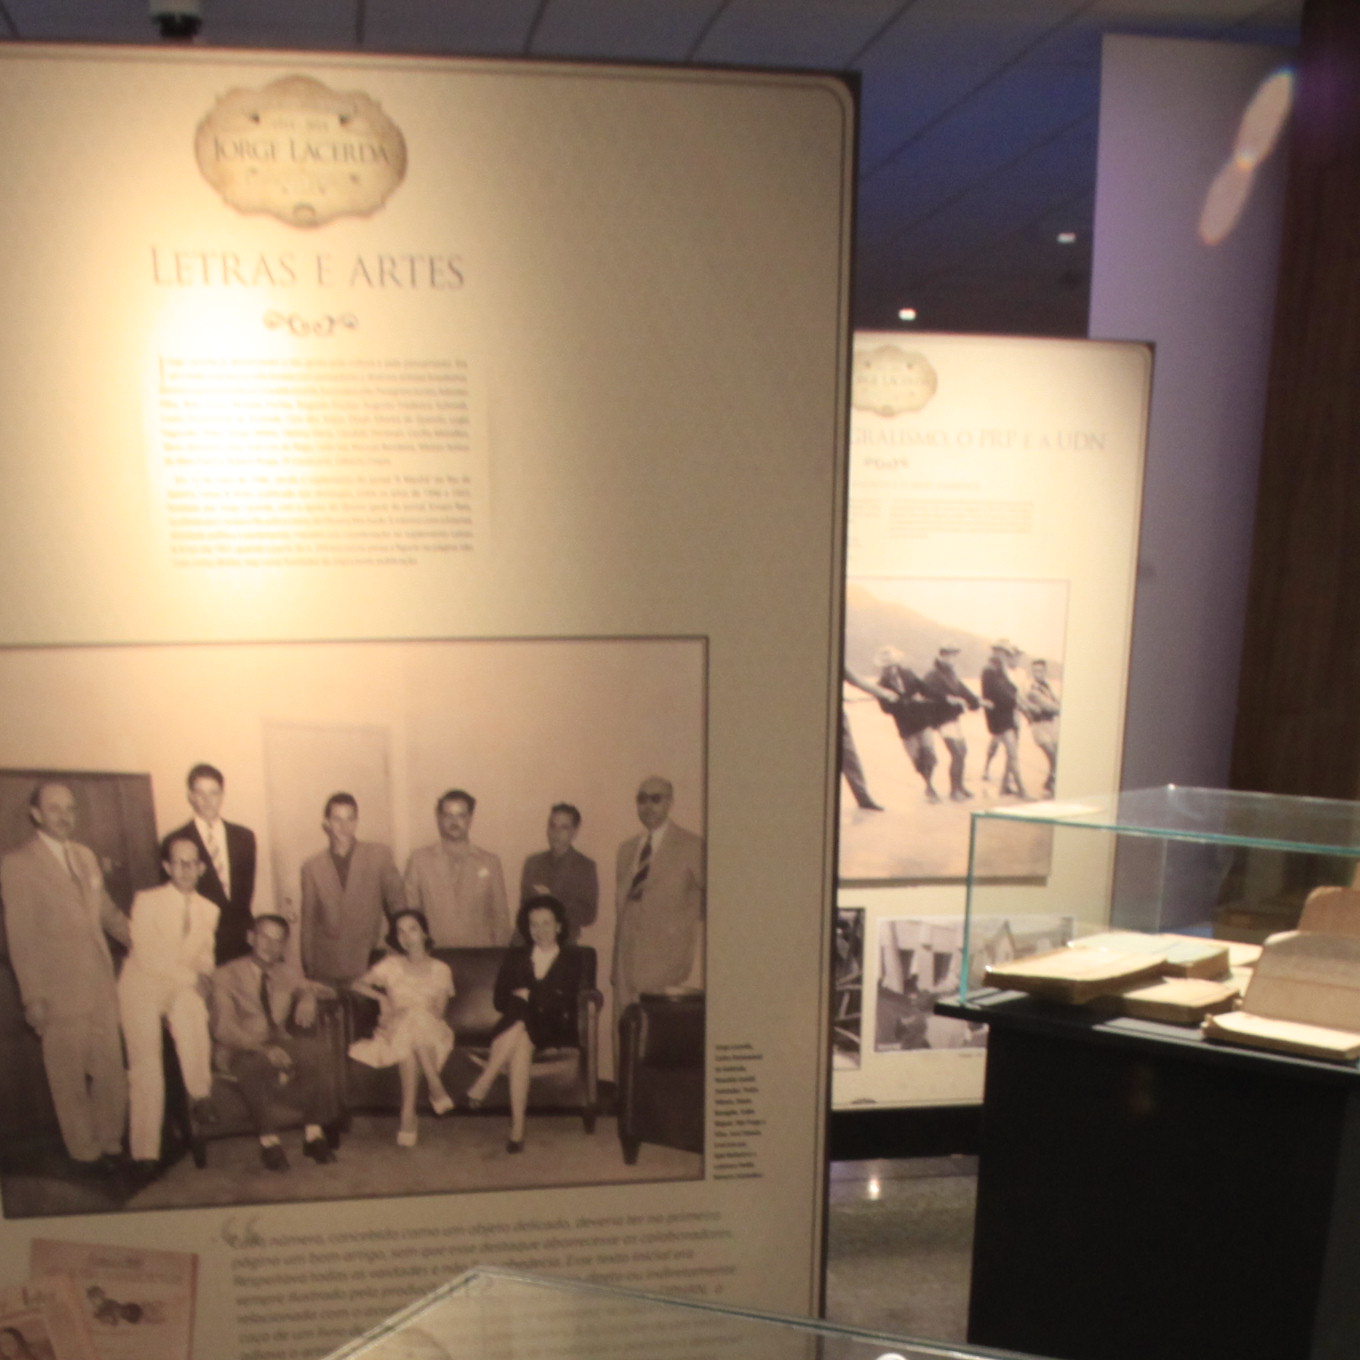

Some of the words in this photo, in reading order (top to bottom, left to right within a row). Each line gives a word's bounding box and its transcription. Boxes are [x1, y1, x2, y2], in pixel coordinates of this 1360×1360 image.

[213, 135, 278, 163] JORGE
[290, 138, 390, 166] LACERDA
[150, 246, 296, 287] LETRAS
[316, 252, 333, 286] E
[350, 254, 465, 290] ARTES
